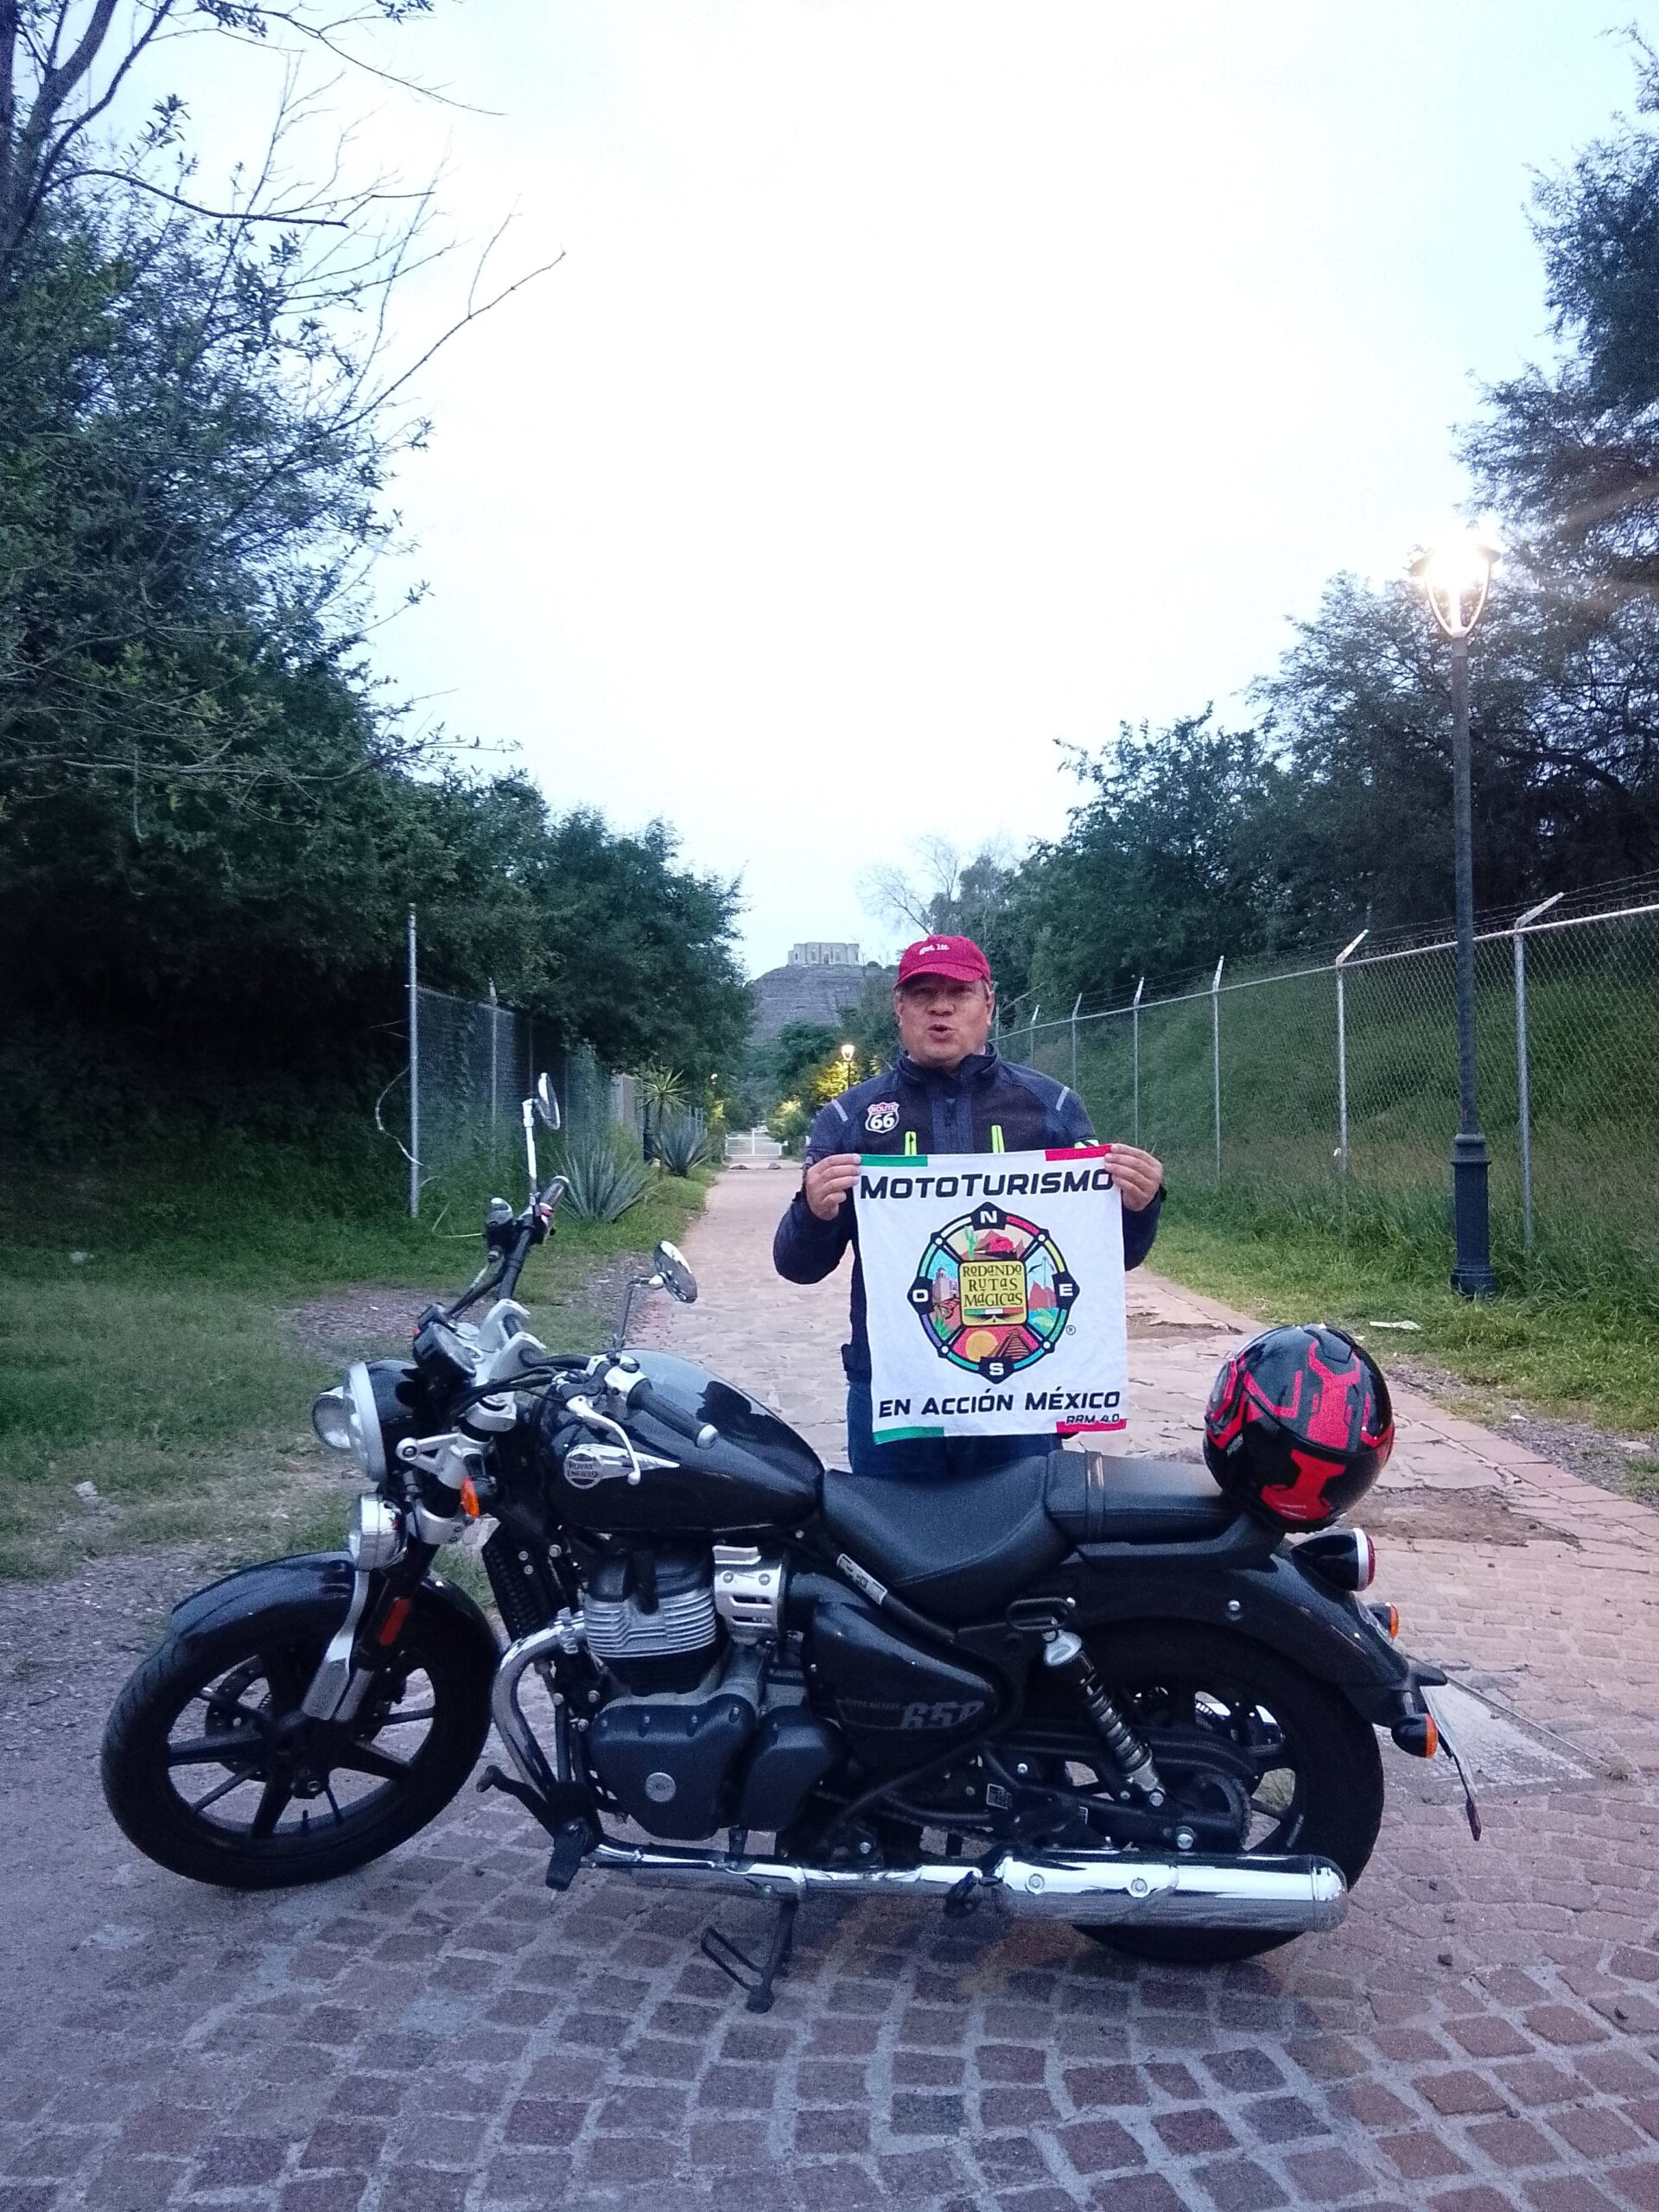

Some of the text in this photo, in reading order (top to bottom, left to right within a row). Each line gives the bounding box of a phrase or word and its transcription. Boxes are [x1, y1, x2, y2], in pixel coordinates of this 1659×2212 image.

[869, 1112, 895, 1129] 66
[860, 1168, 1114, 1200] MOTOTURISMO
[980, 1210, 998, 1224] N
[1059, 1282, 1073, 1297] E
[988, 1361, 1005, 1376] S
[878, 1386, 1121, 1418] EN ACCIÓN MÉXICO
[1100, 1413, 1121, 1423] 4.0
